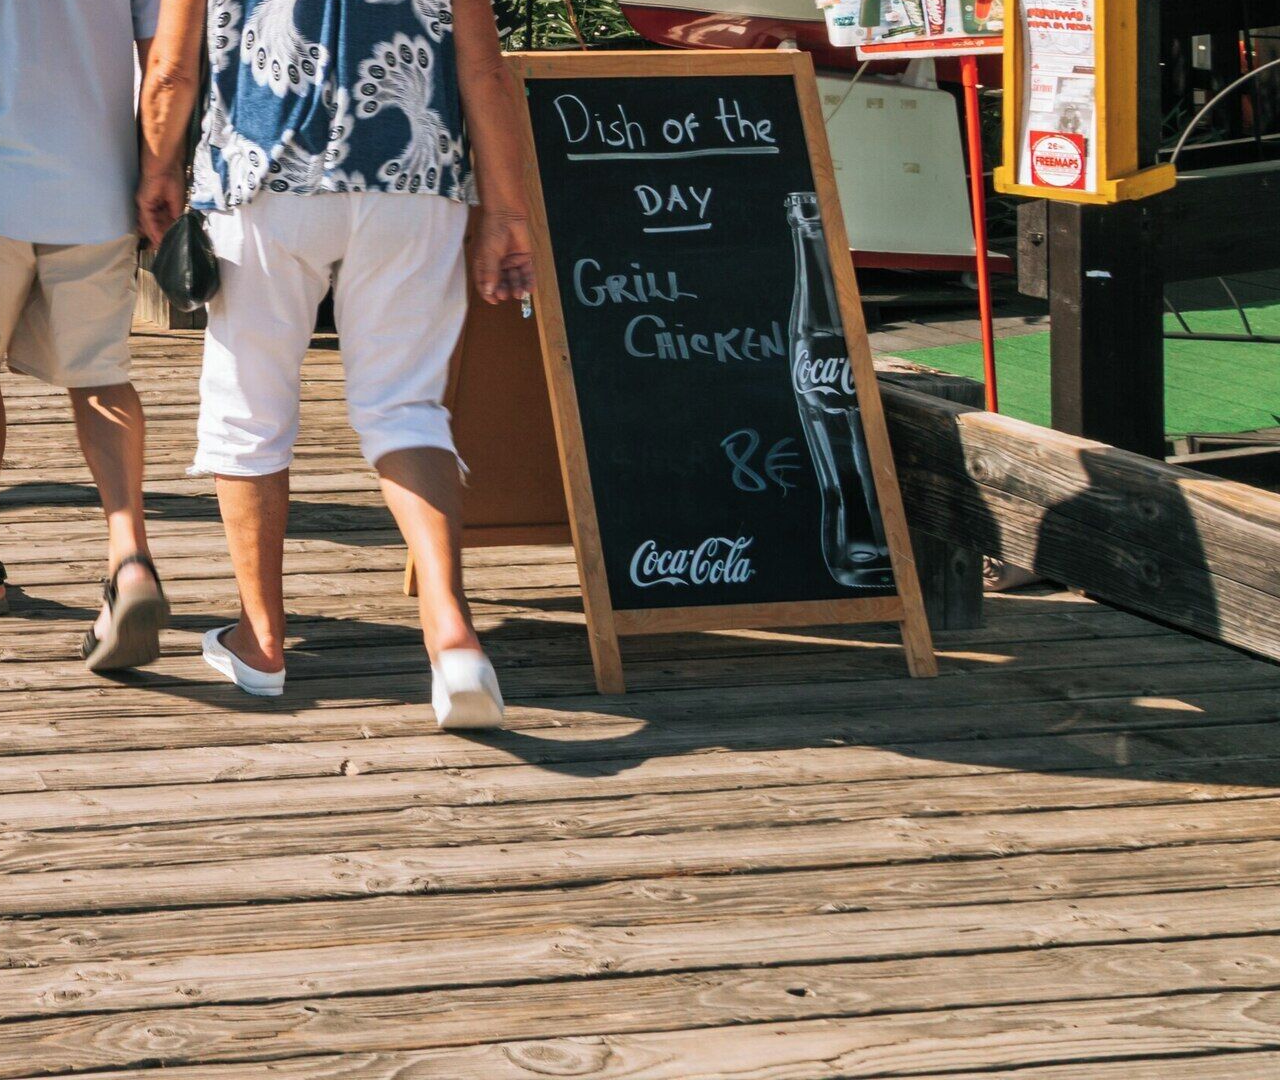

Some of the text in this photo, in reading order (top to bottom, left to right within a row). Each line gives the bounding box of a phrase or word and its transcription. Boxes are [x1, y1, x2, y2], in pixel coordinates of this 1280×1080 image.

[552, 93, 646, 150] Dish
[714, 97, 777, 144] the
[1035, 156, 1079, 169] FREEMAPS
[633, 184, 712, 219] DAY
[629, 536, 754, 588] Coca-Cola
